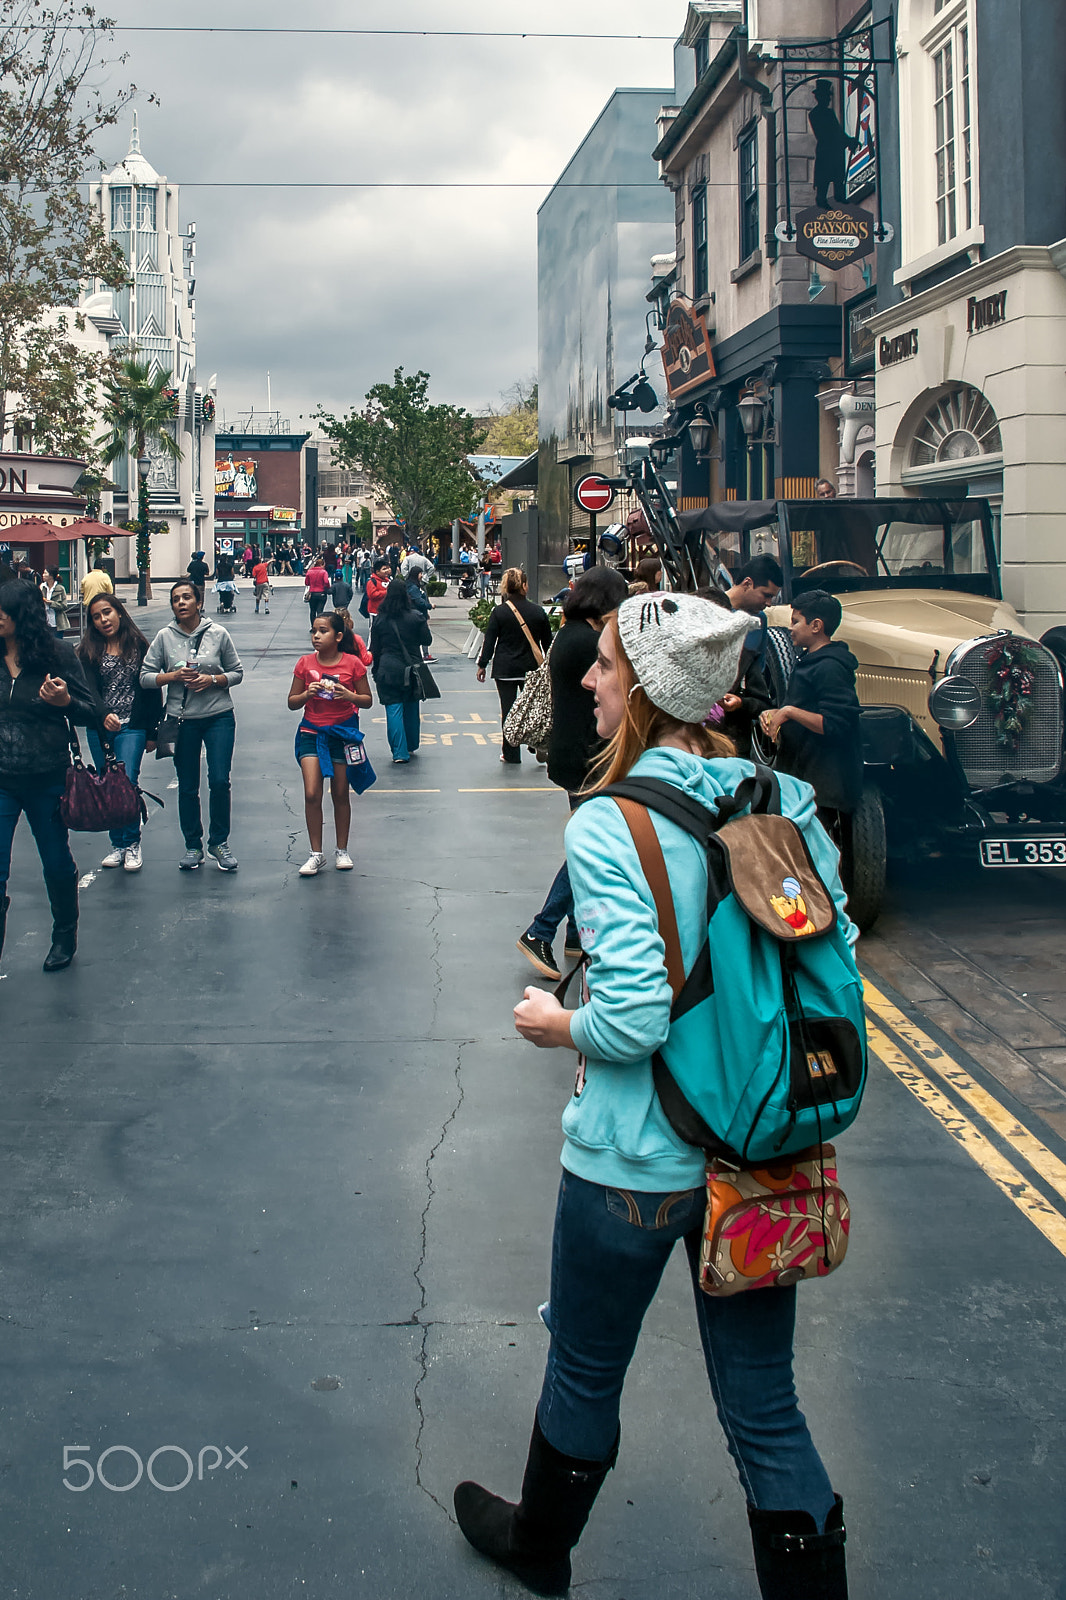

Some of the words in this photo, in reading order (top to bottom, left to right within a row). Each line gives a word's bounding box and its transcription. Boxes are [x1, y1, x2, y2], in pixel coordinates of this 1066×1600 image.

[803, 221, 869, 239] GRAYSONS
[0, 467, 27, 494] N
[319, 518, 334, 526] STAGE
[986, 842, 1019, 863] EL
